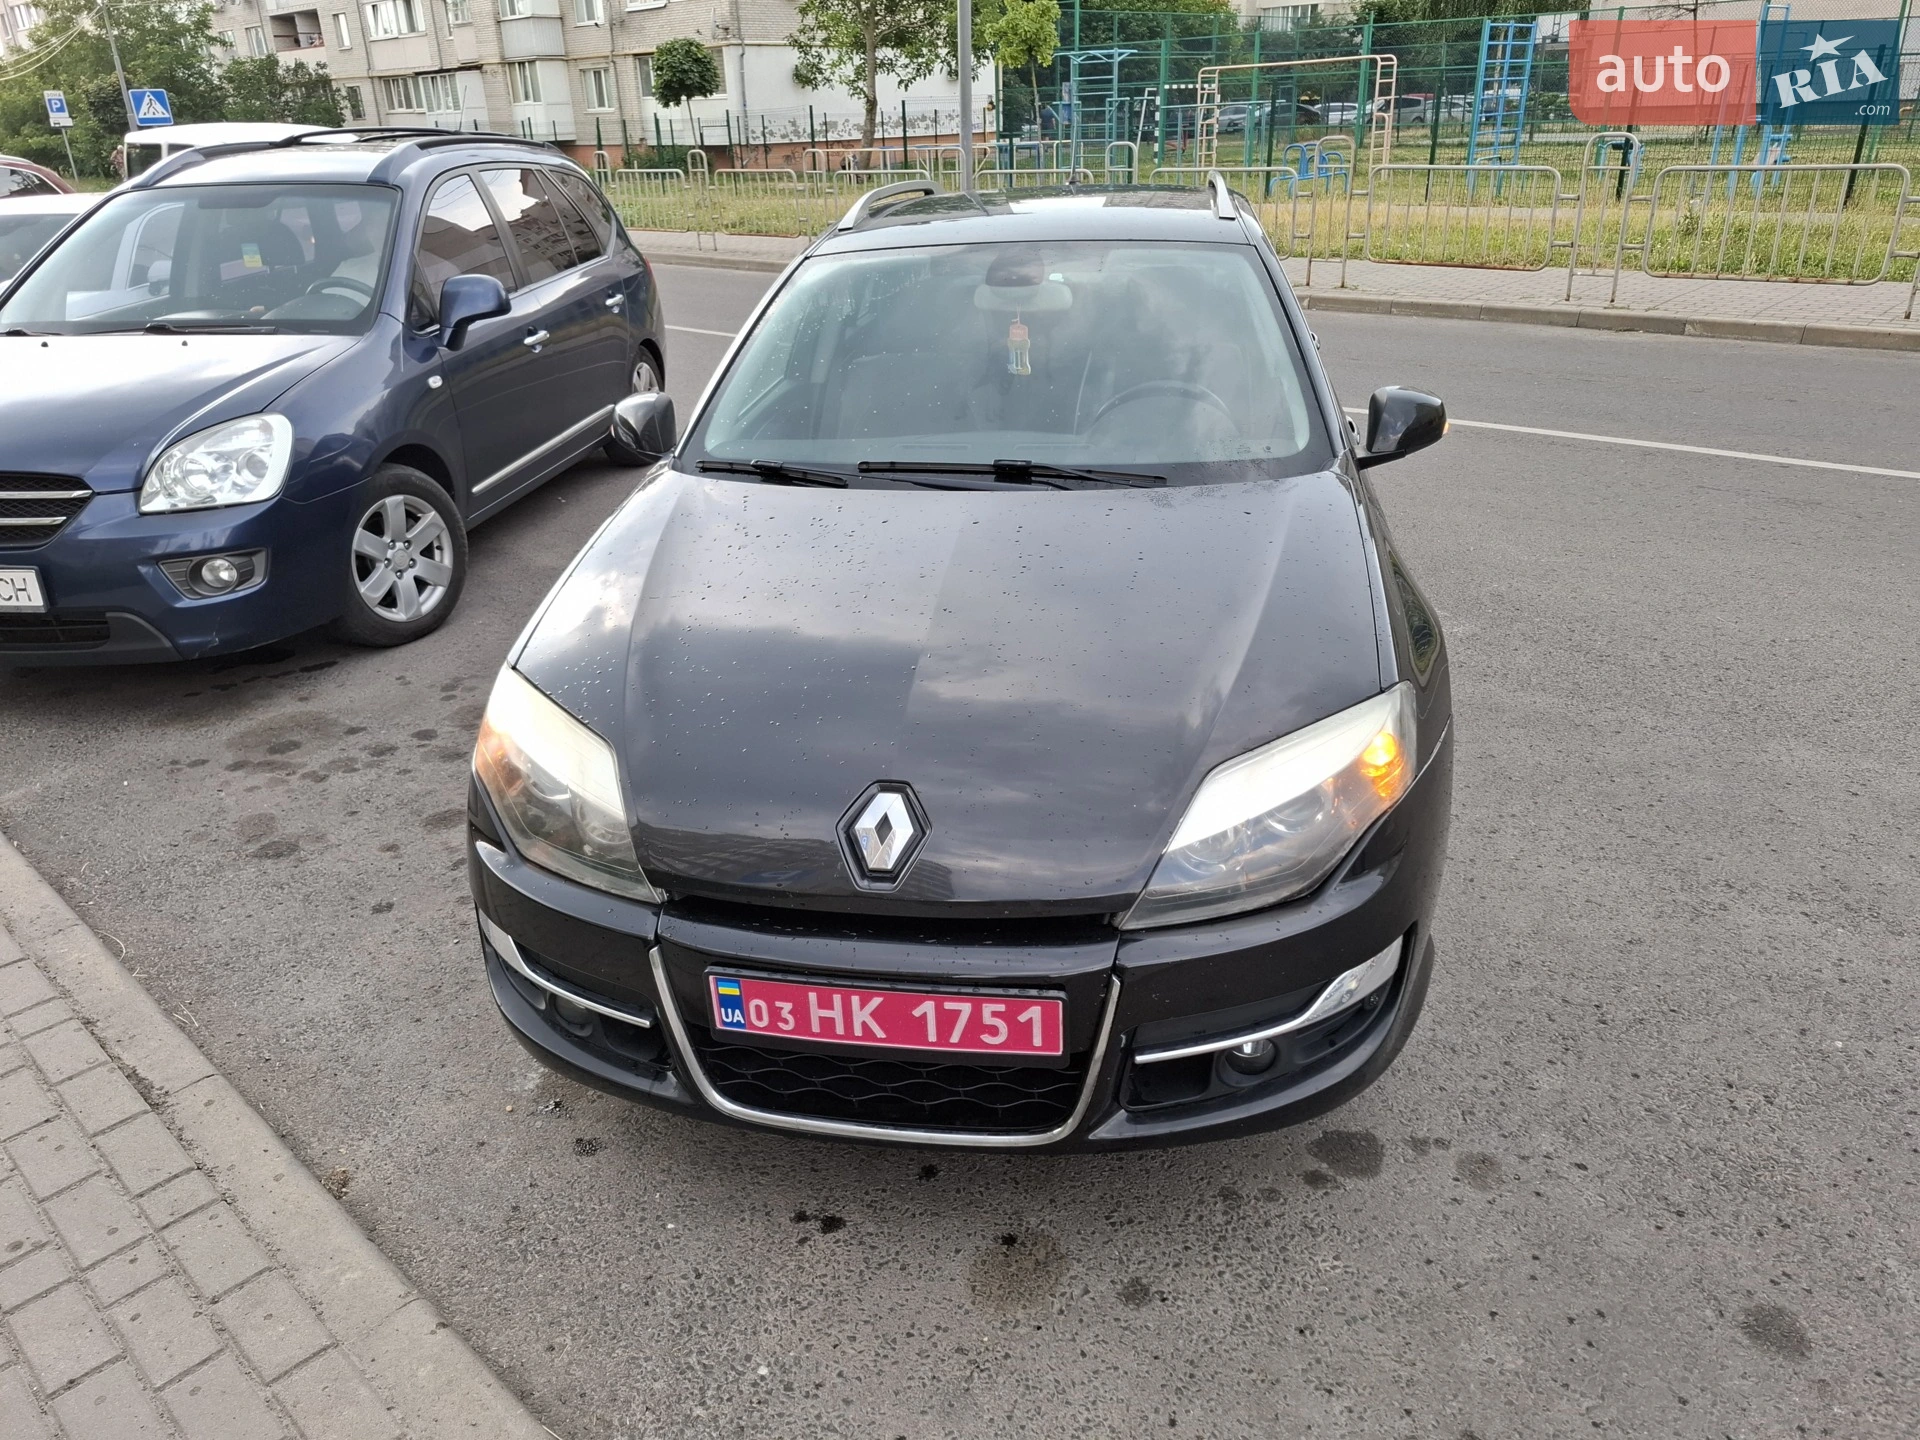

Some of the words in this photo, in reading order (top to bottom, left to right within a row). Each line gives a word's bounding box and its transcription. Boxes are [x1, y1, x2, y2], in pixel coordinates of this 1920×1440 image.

[51, 99, 61, 112] P
[721, 1006, 745, 1024] UA
[808, 991, 887, 1039] HK
[911, 1000, 1042, 1047] 1751
